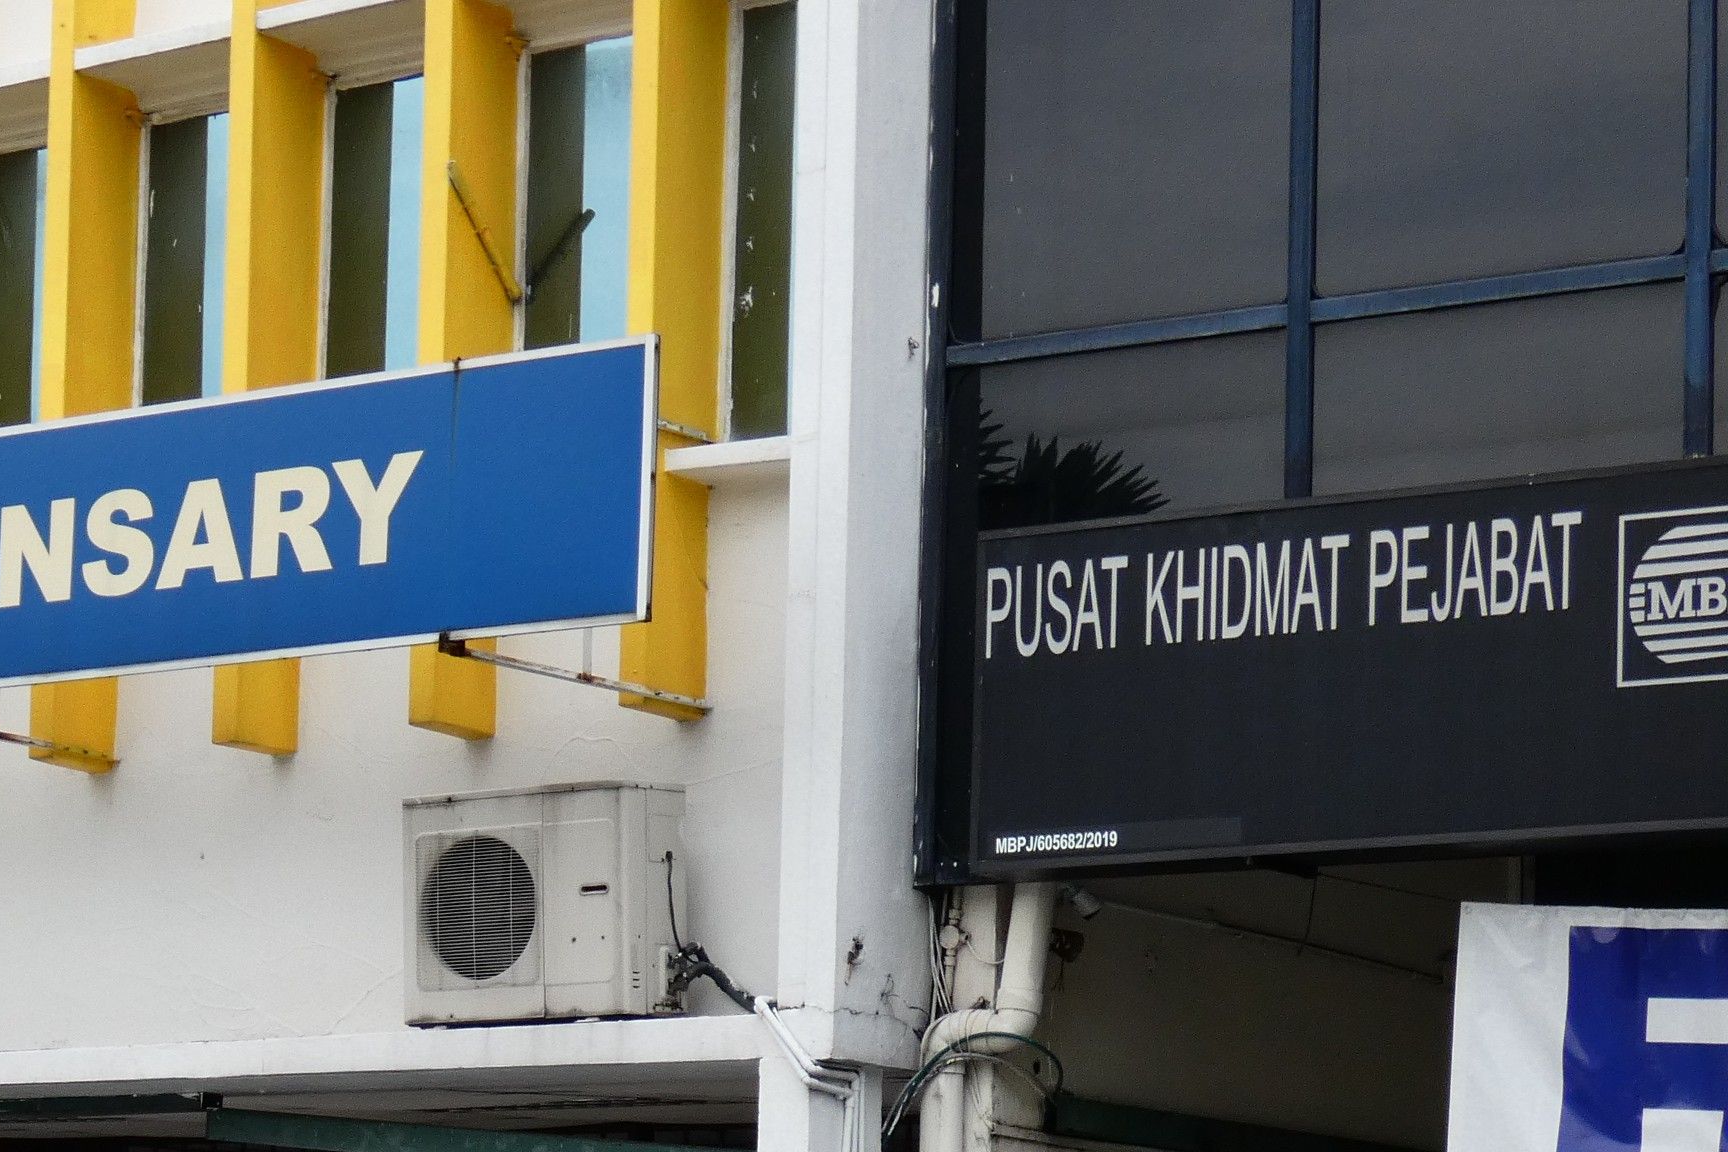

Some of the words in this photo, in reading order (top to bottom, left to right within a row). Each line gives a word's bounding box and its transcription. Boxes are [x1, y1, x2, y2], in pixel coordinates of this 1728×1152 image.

[985, 555, 1129, 659] PUSAT
[1145, 534, 1350, 646] KHIDMAT
[1368, 511, 1582, 627] PEJABAT
[995, 828, 1118, 856] MBPJ/605682/2019
